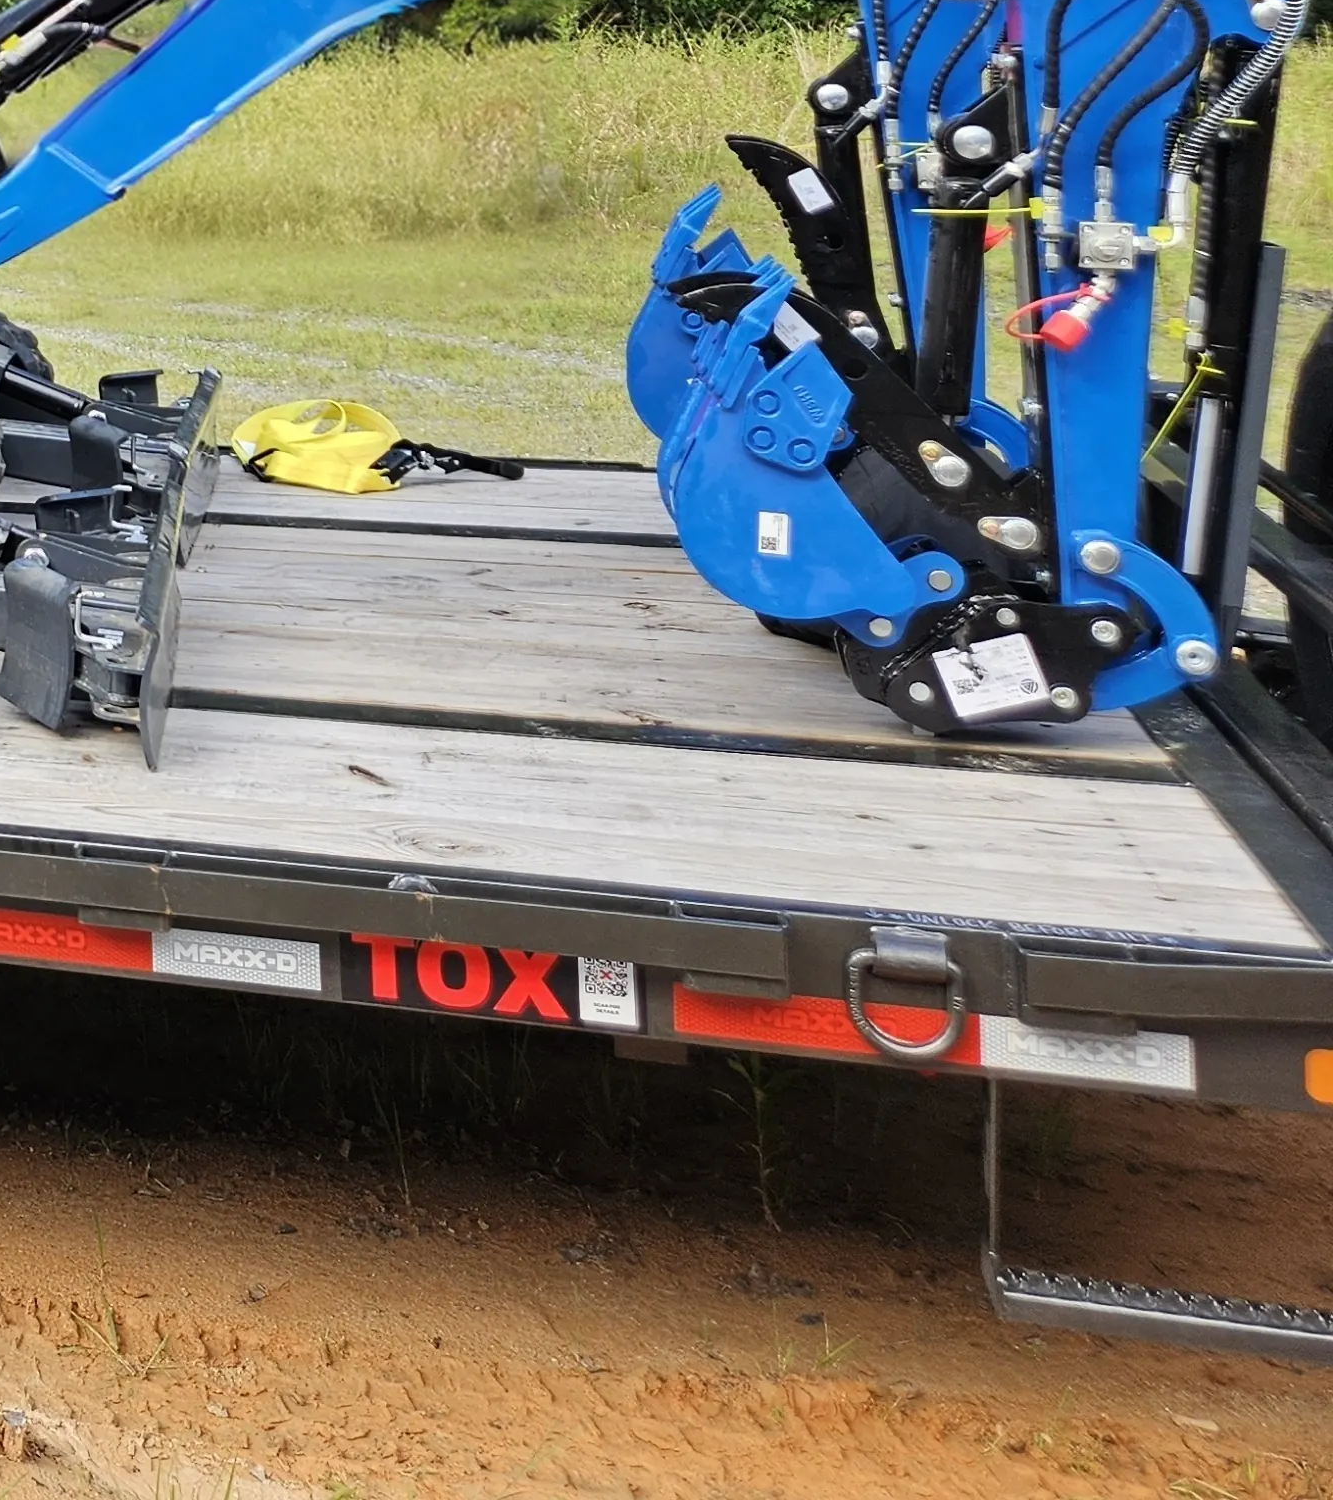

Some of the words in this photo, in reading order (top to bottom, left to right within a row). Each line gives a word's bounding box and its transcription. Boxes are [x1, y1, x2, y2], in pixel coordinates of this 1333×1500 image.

[906, 912, 1000, 930] UNLOCK
[174, 942, 298, 973] MAXX-D
[351, 932, 570, 1020] TOX
[1007, 1031, 1163, 1069] MAXX-D
